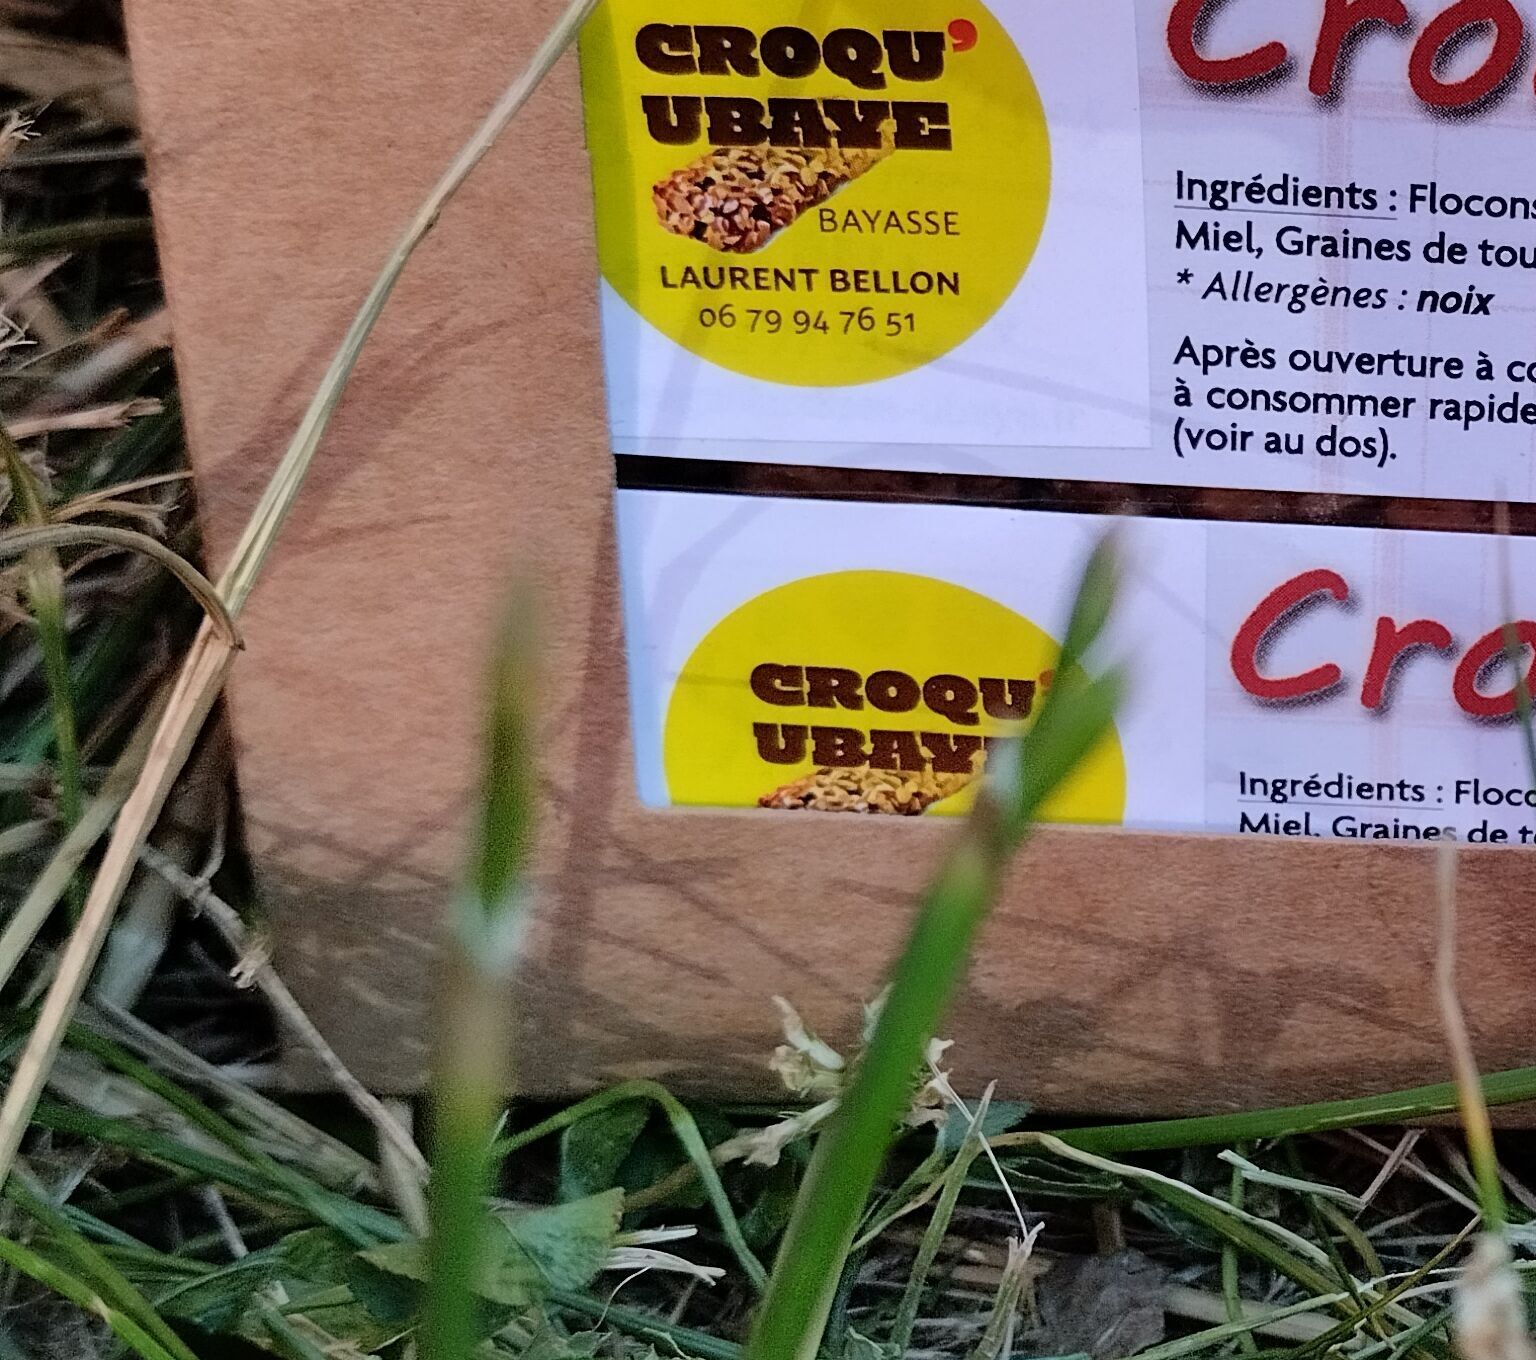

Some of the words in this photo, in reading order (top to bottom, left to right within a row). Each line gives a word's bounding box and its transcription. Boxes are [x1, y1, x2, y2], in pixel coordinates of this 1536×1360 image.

[640, 94, 954, 152] UBAYE
[1174, 169, 1378, 212] Ingrédients
[818, 207, 961, 237] BAYASSE
[1174, 219, 1265, 259] Miel,
[1275, 225, 1412, 263] Graines
[1421, 231, 1468, 265] de
[659, 264, 821, 293] LAURENT
[830, 267, 961, 297] BELLON
[1201, 269, 1389, 313] Allergènes
[1416, 283, 1496, 317] noix
[699, 305, 736, 330] 06
[746, 307, 782, 334] 79
[793, 309, 830, 336] 94
[839, 305, 876, 336] 76
[886, 311, 916, 338] 51
[1173, 334, 1277, 376] Après
[1288, 347, 1465, 380] ouverture
[1475, 350, 1495, 382] à
[1172, 376, 1192, 408] à
[1205, 384, 1417, 420] consommer
[1172, 416, 1255, 458] (voir
[1263, 430, 1305, 457] au
[1314, 424, 1398, 468] dos).
[752, 721, 1020, 775] UBAY
[1239, 770, 1426, 804] Ingrédients
[1467, 819, 1508, 844] de
